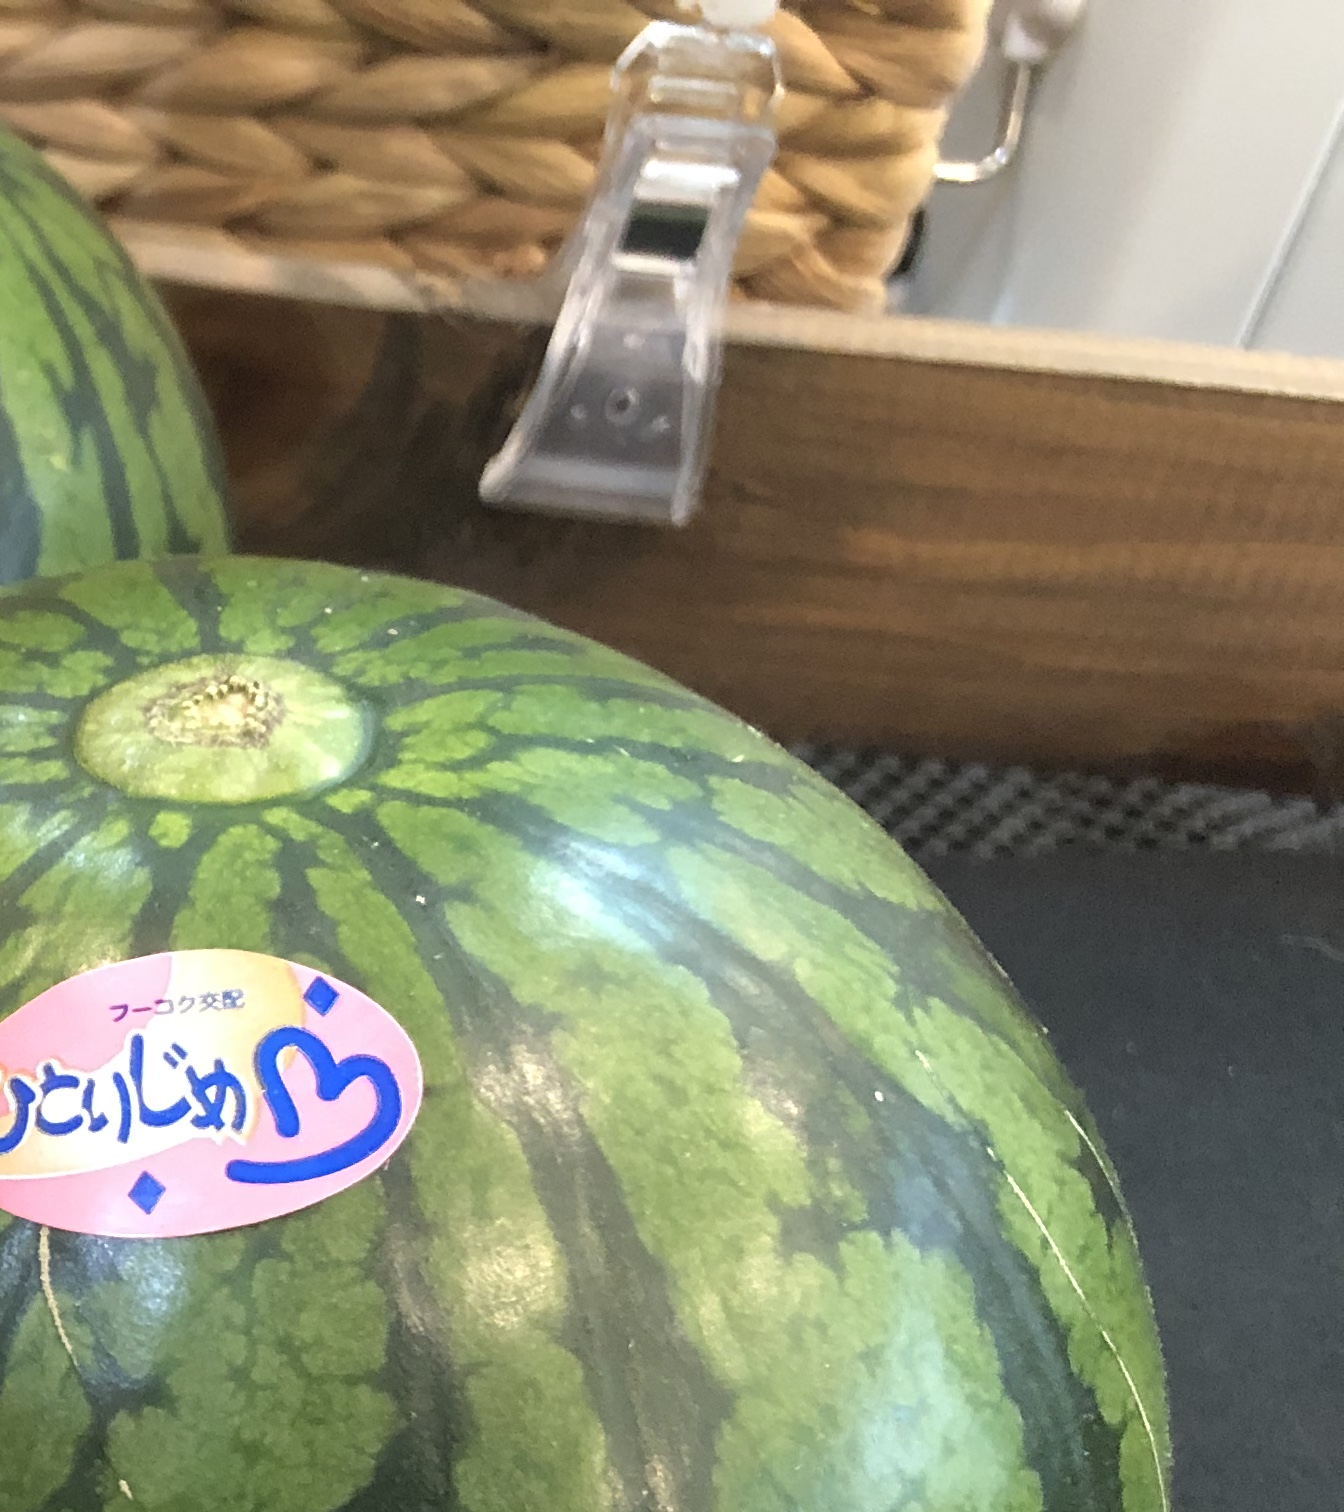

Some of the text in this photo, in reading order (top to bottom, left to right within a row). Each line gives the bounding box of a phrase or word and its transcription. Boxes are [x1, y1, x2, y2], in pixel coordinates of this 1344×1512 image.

[109, 988, 246, 1023] フーコク交配
